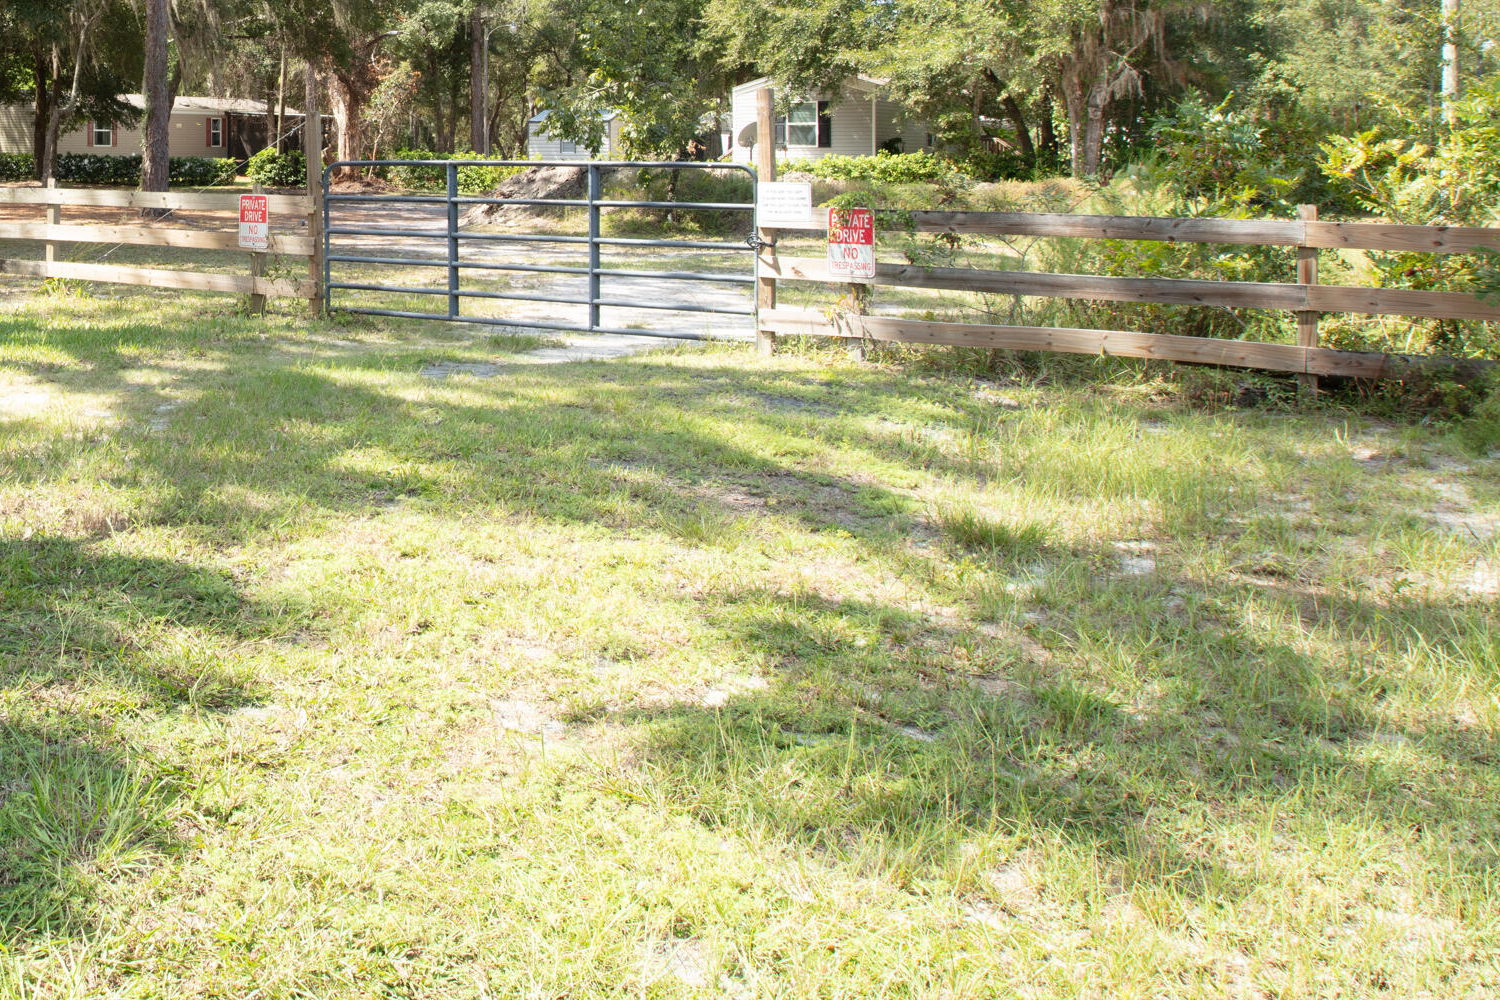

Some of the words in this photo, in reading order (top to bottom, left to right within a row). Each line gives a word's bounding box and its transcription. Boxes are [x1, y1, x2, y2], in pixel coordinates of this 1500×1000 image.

[242, 199, 265, 210] PRIVATE
[244, 211, 262, 222] DRIVE
[831, 214, 871, 228] PVATE
[248, 225, 258, 234] NO
[836, 228, 866, 243] DRIVE
[843, 247, 859, 260] NO
[831, 261, 871, 271] TRESPASSING
